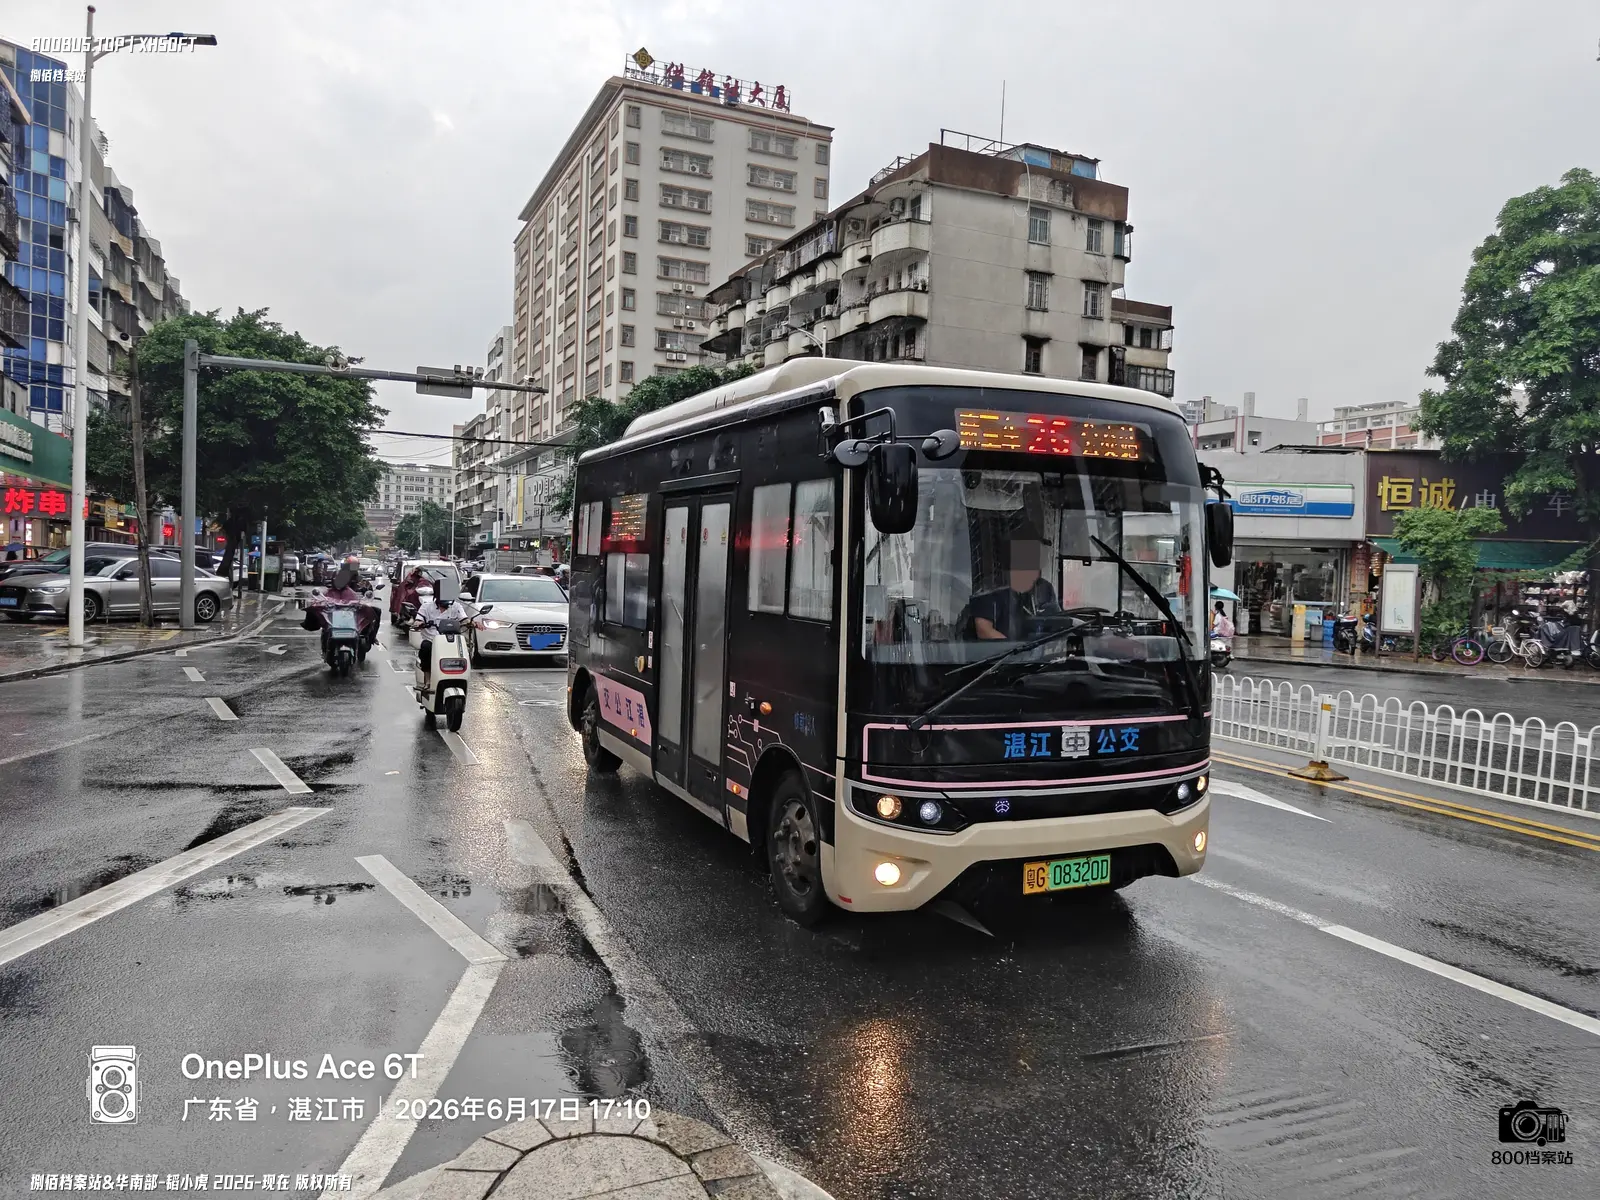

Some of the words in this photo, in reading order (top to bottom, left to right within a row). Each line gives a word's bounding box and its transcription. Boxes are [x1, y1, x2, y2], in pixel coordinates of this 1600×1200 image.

[1240, 492, 1303, 505] 都市邻居
[1377, 475, 1456, 512] 恒诚
[1004, 732, 1051, 758] 湛江
[1097, 727, 1139, 753] 公交
